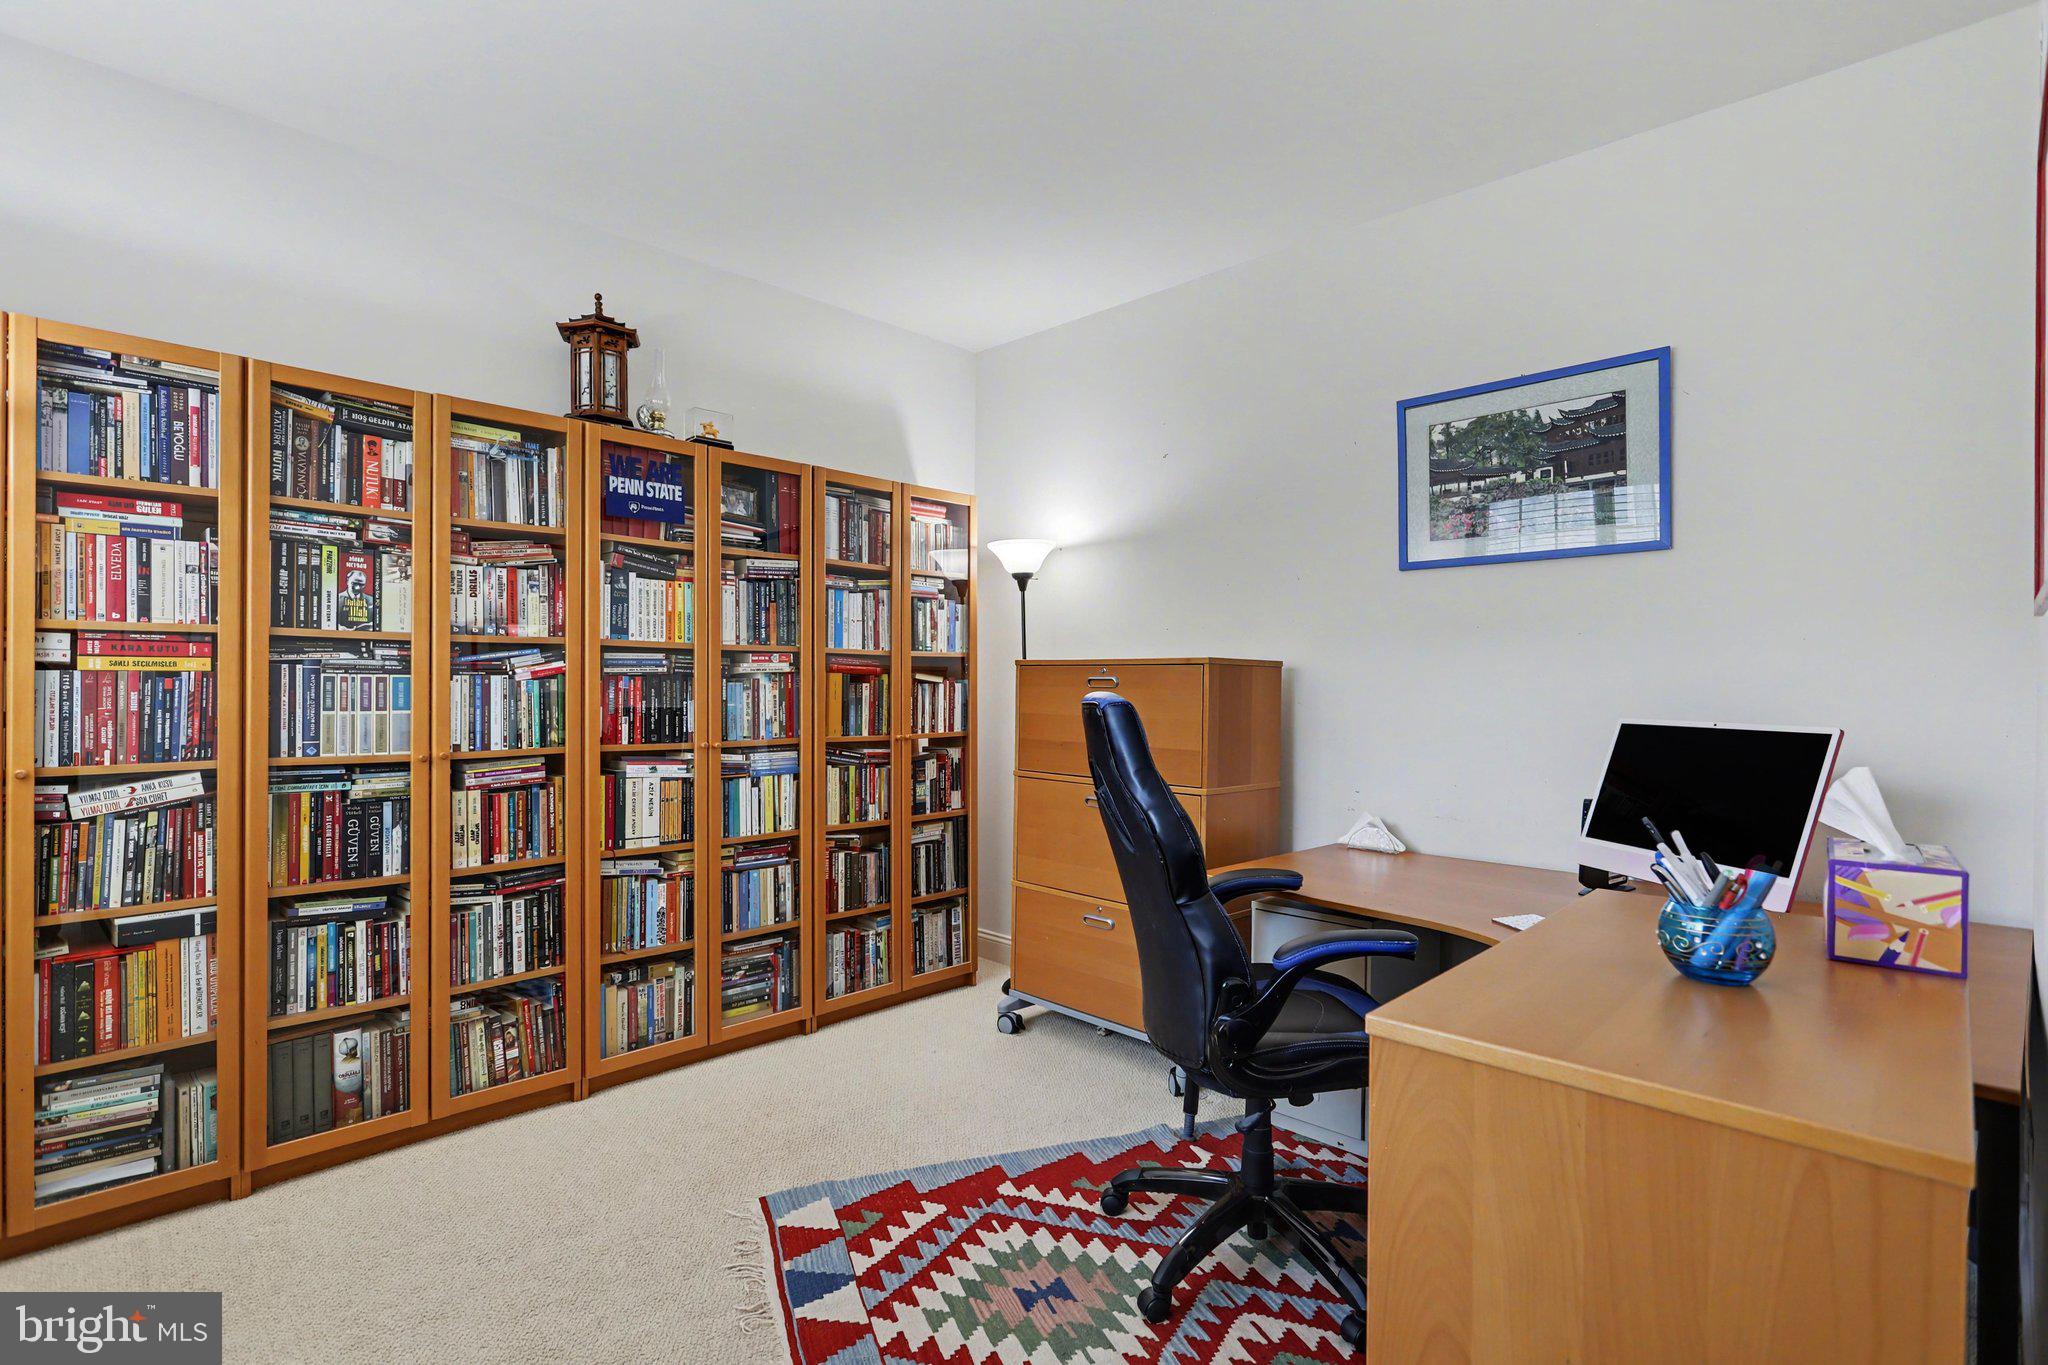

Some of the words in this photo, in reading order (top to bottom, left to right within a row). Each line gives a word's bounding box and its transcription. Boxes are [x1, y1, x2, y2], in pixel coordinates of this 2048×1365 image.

[273, 409, 282, 445] ATATÜRK
[352, 412, 367, 423] HOŞ
[368, 414, 395, 427] GELDİN
[173, 421, 185, 461] BEYOĞLU
[273, 450, 282, 482] NUTUK
[297, 450, 308, 494] ÇANKAYA
[366, 460, 379, 495] NUTUK
[609, 475, 644, 496] PENN
[646, 481, 682, 502] STATE
[111, 543, 122, 580] ELVEDA
[111, 644, 142, 652] KARA
[148, 645, 179, 653] KUTU
[79, 792, 102, 804] YILMAZ
[81, 804, 104, 817] YILMAZ
[347, 819, 361, 863] GÜVEN
[370, 816, 380, 851] GÜVEN
